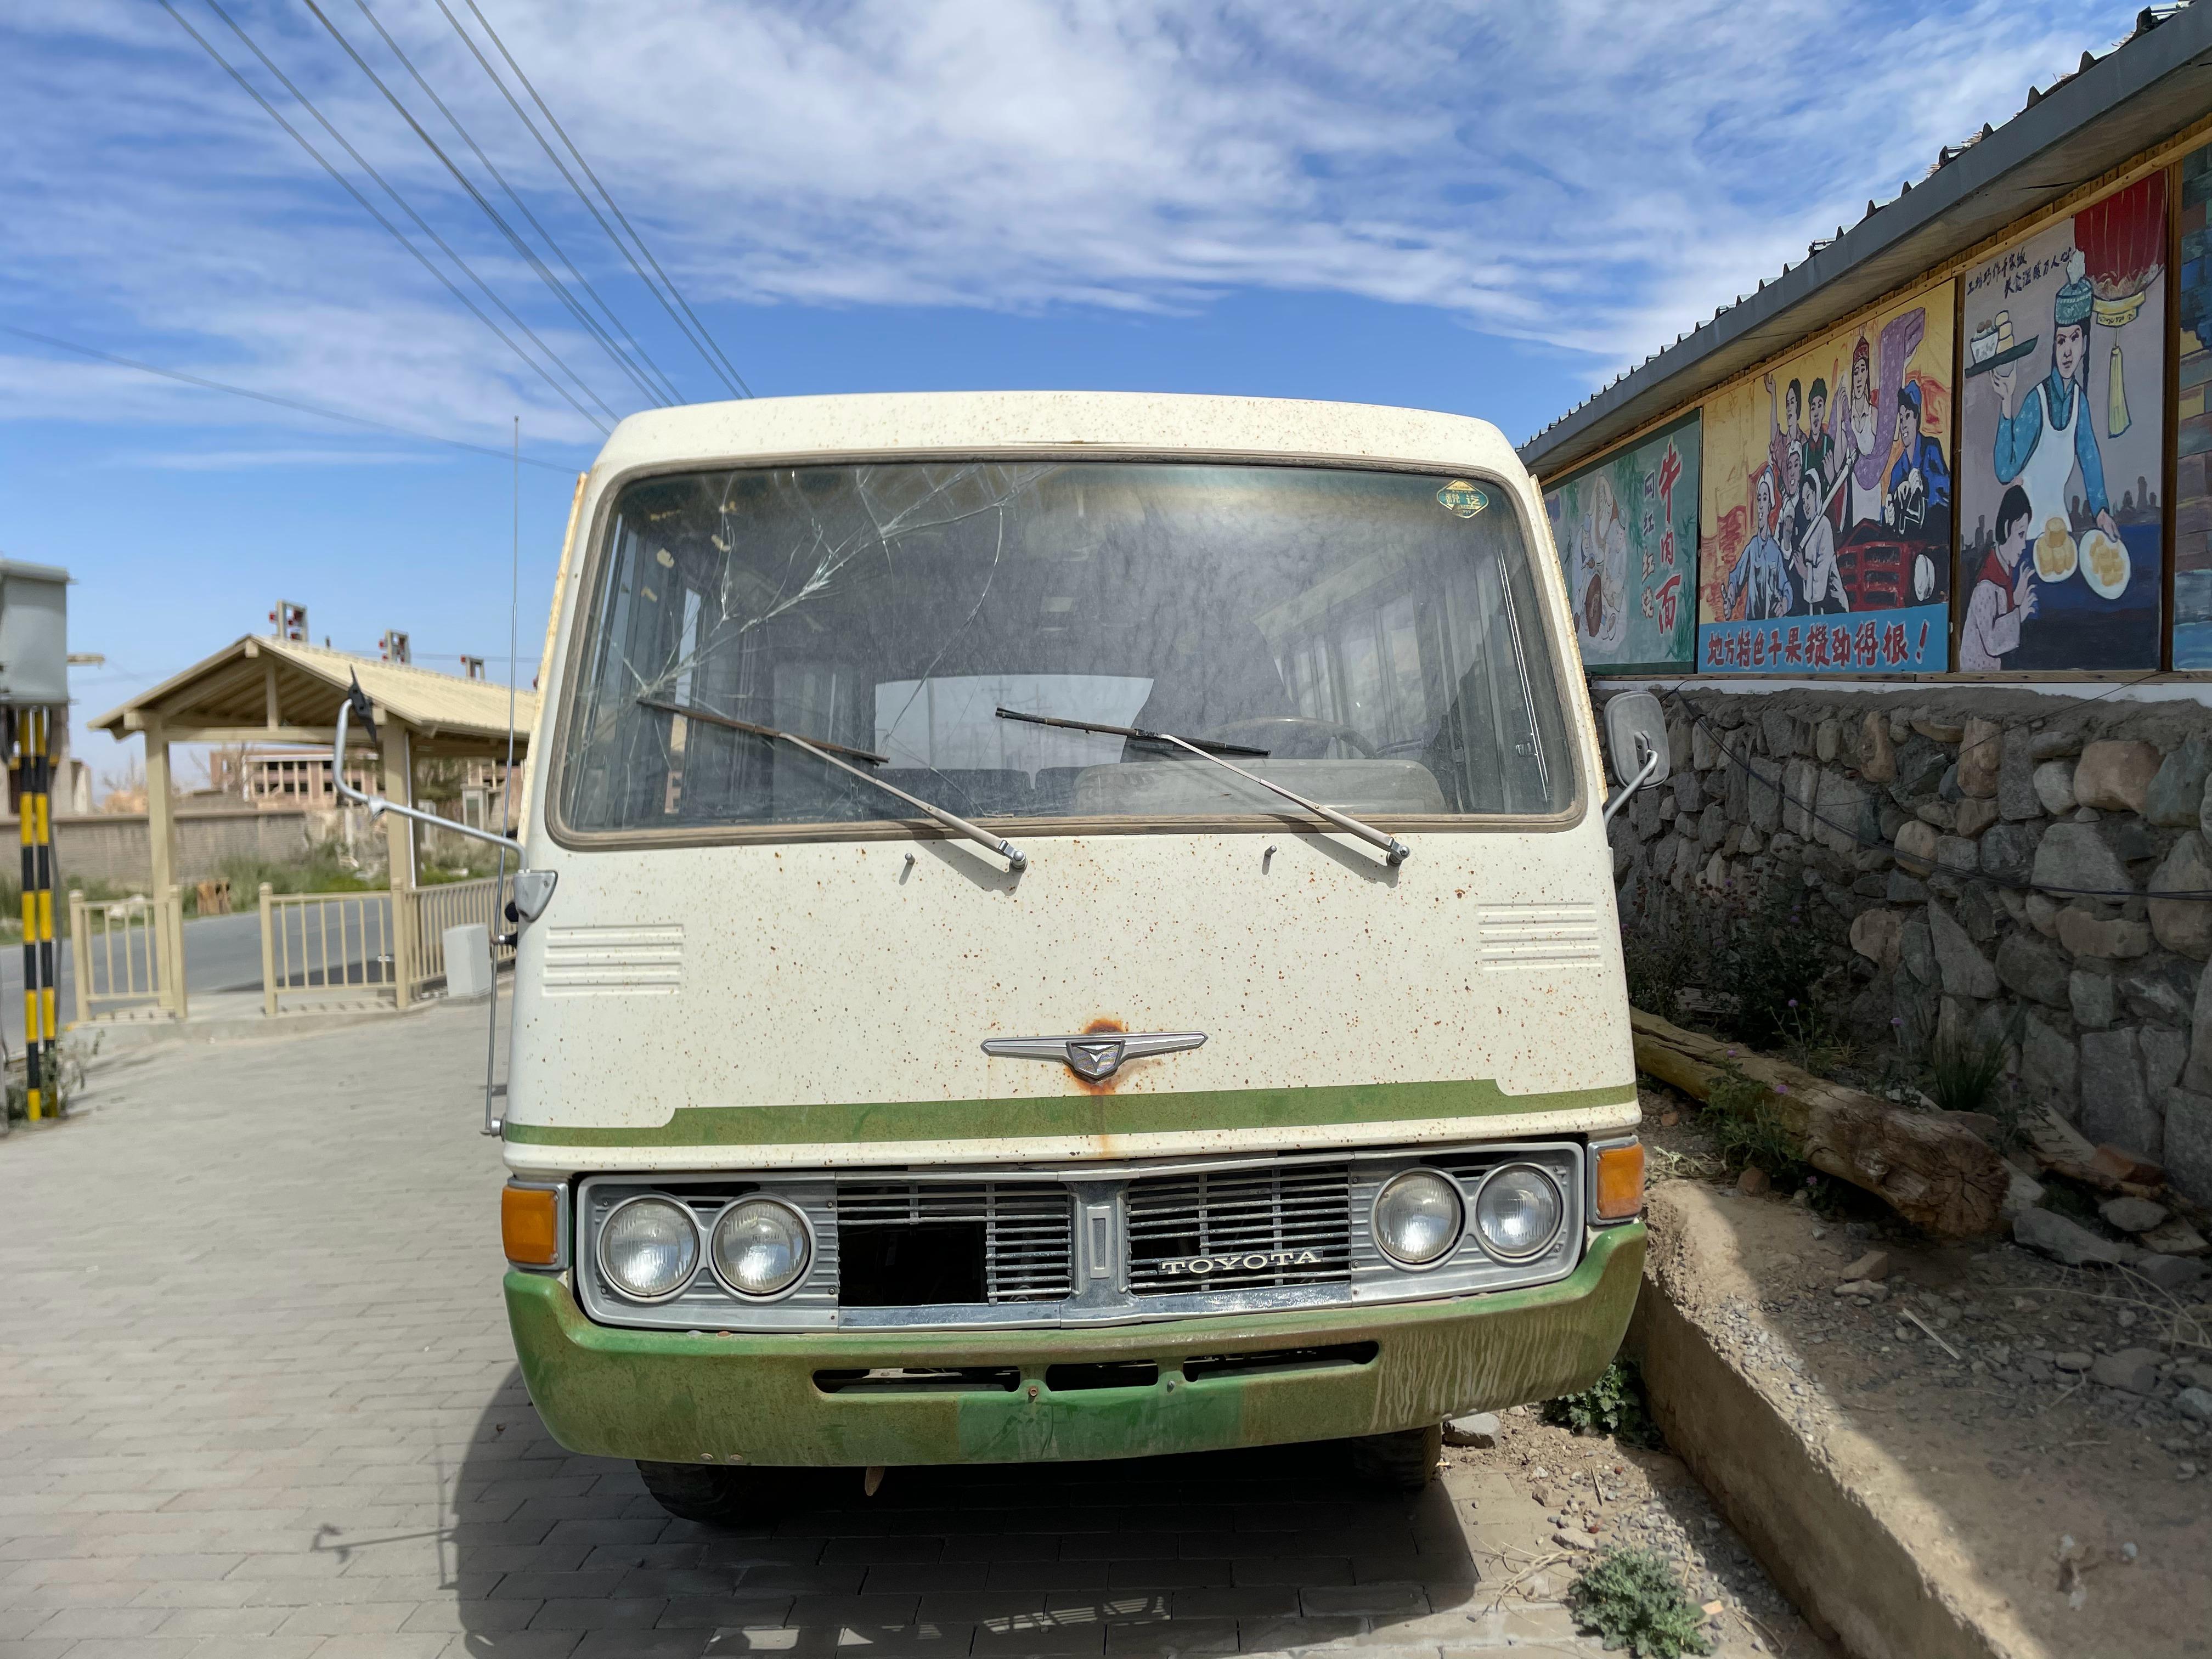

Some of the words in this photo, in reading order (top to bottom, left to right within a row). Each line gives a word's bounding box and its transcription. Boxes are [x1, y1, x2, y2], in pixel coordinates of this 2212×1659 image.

[1656, 439, 1681, 635] 牛肉面
[1161, 1250, 1321, 1275] TOYOTA
